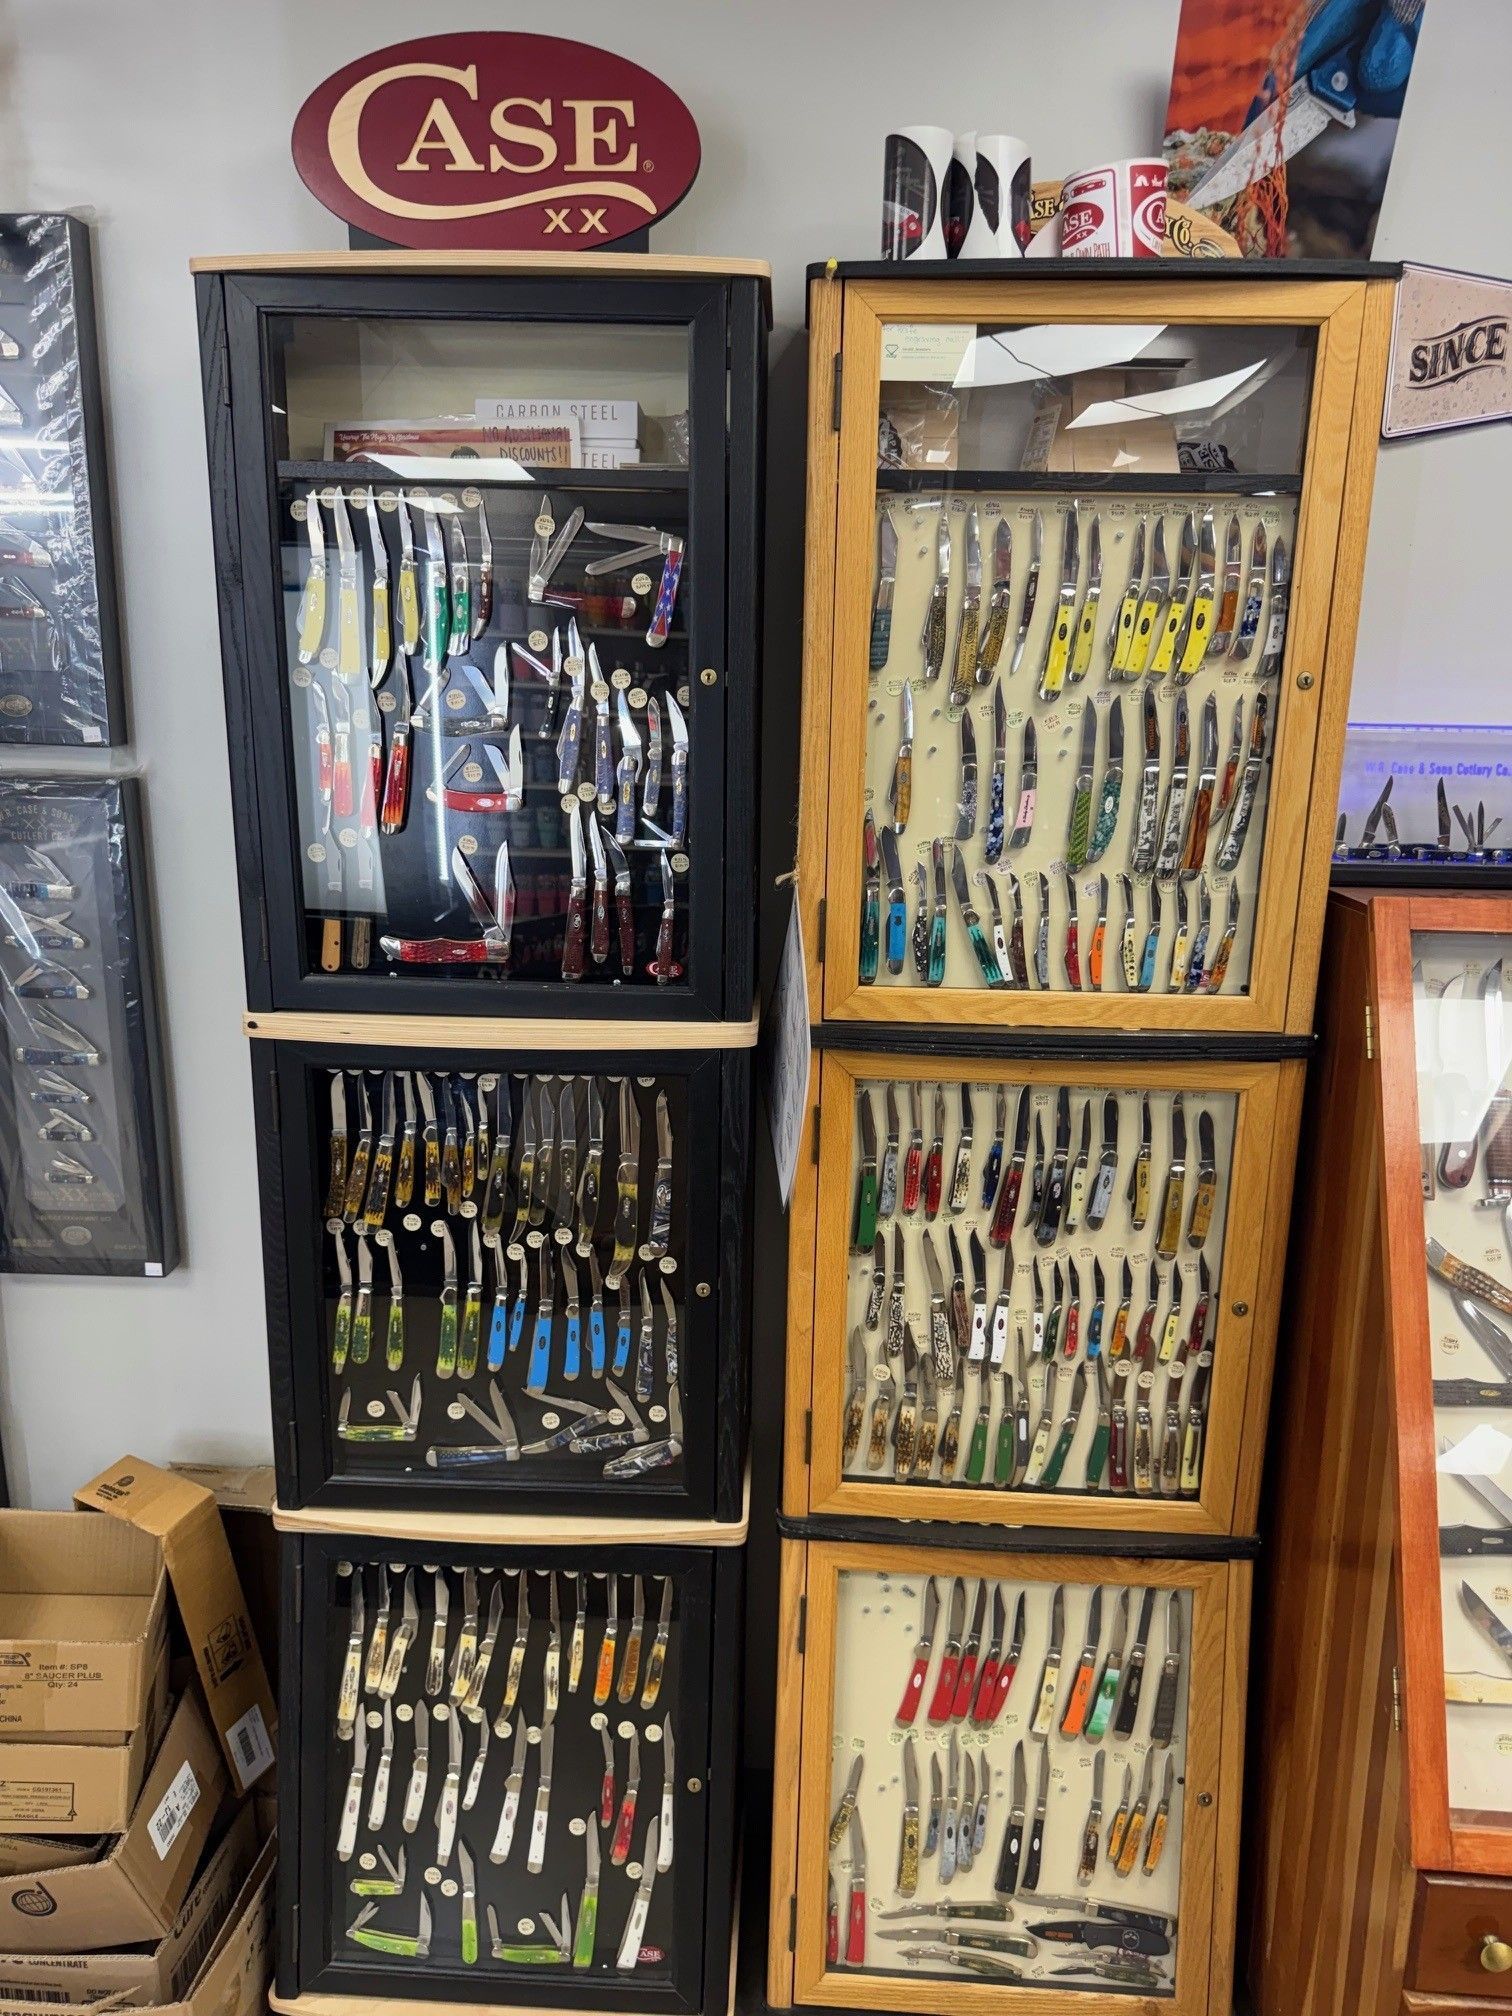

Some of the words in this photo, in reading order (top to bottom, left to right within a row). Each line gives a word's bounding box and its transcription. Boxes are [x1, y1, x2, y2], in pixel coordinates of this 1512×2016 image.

[1063, 209, 1093, 234] ASE
[1409, 323, 1508, 383] SINCE
[496, 404, 561, 418] CARBON
[570, 404, 618, 421] STEEL
[581, 452, 618, 469] TEEL
[1457, 763, 1493, 778] Cutlery
[47, 1681, 66, 1689] Qty:
